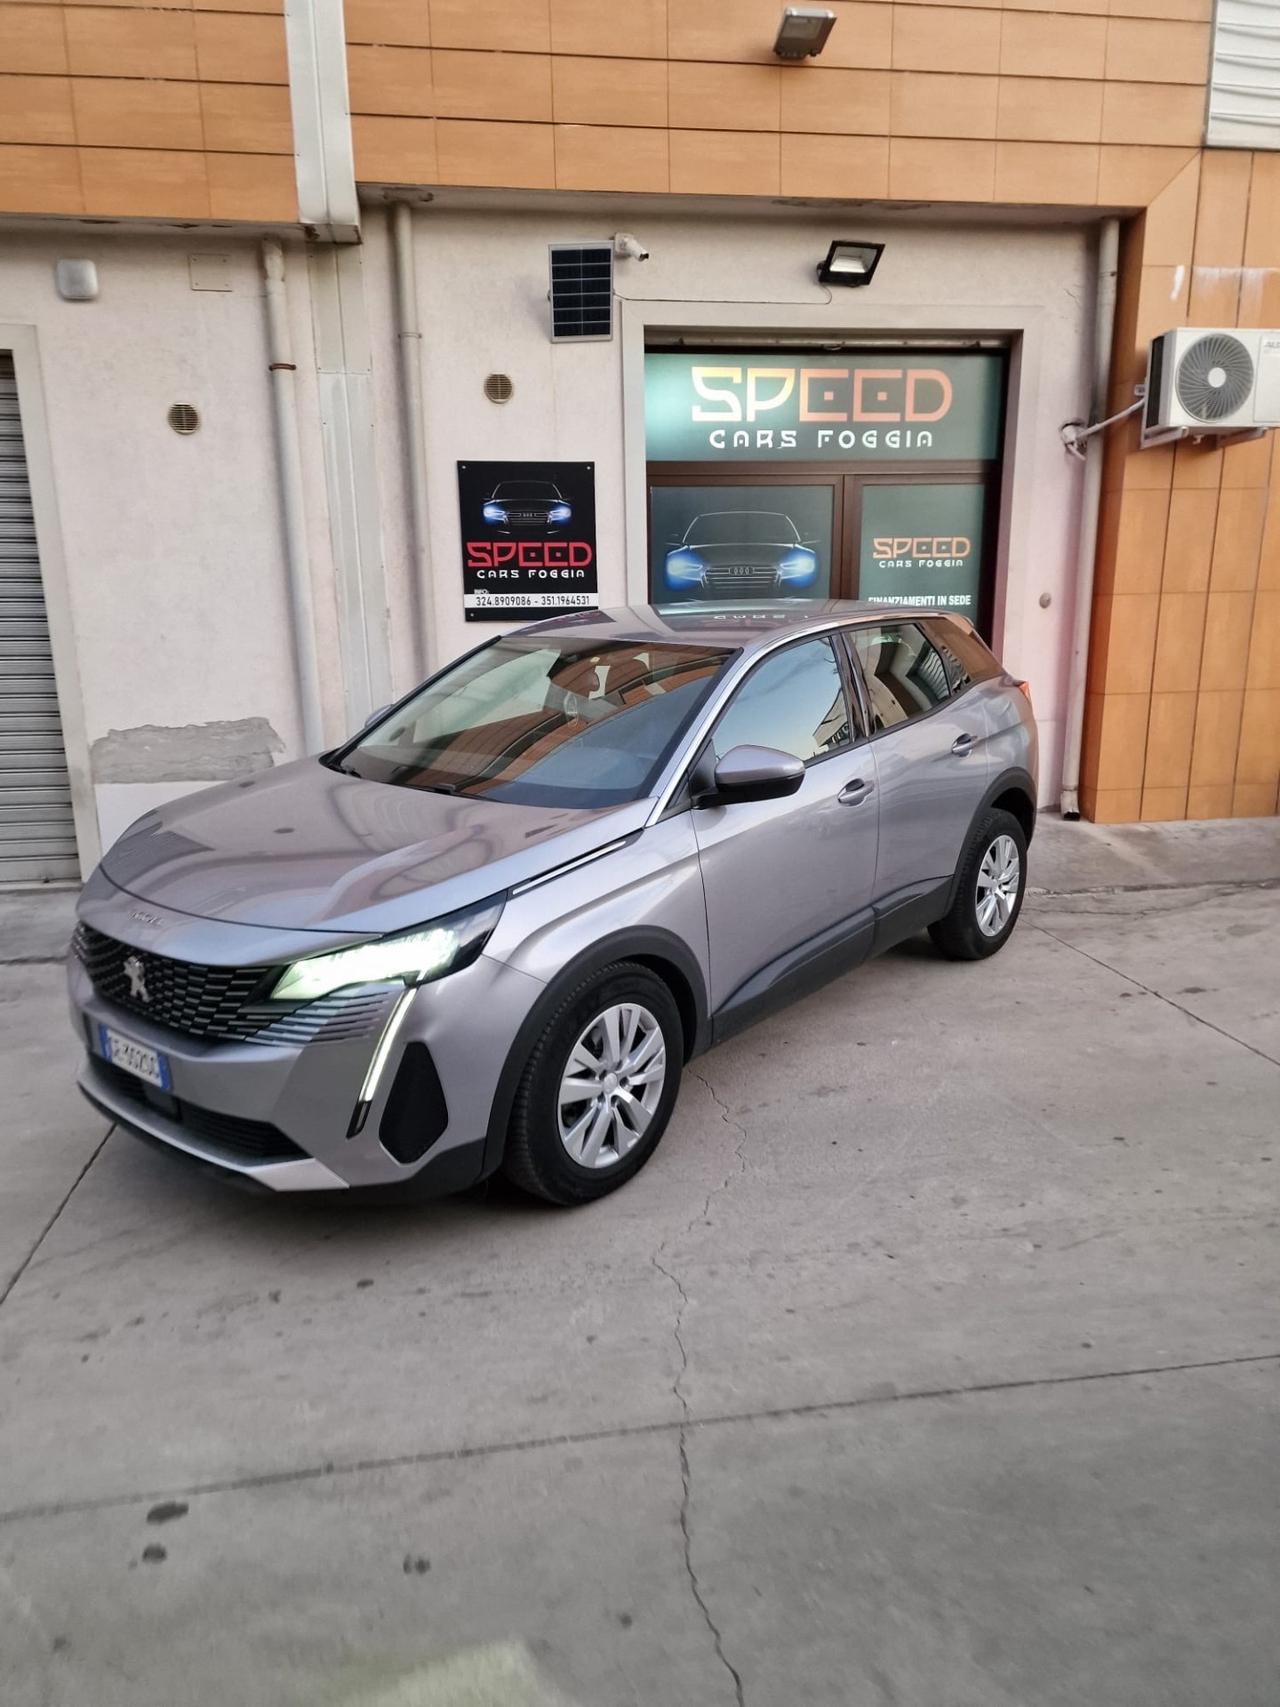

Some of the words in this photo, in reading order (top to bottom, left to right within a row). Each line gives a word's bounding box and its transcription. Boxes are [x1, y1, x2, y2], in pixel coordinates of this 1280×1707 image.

[691, 366, 953, 422] SPEED
[709, 429, 797, 449] CARS
[817, 429, 933, 449] FOGGIA
[466, 541, 593, 567] SPEED
[872, 537, 971, 559] SPEED
[879, 560, 913, 568] CARS
[918, 559, 963, 568] FOGGIA
[476, 569, 520, 579] CARS
[528, 569, 585, 579] FOGGIA
[475, 596, 532, 607] 324.8909086
[937, 595, 947, 606] IN
[948, 594, 972, 606] SEDE
